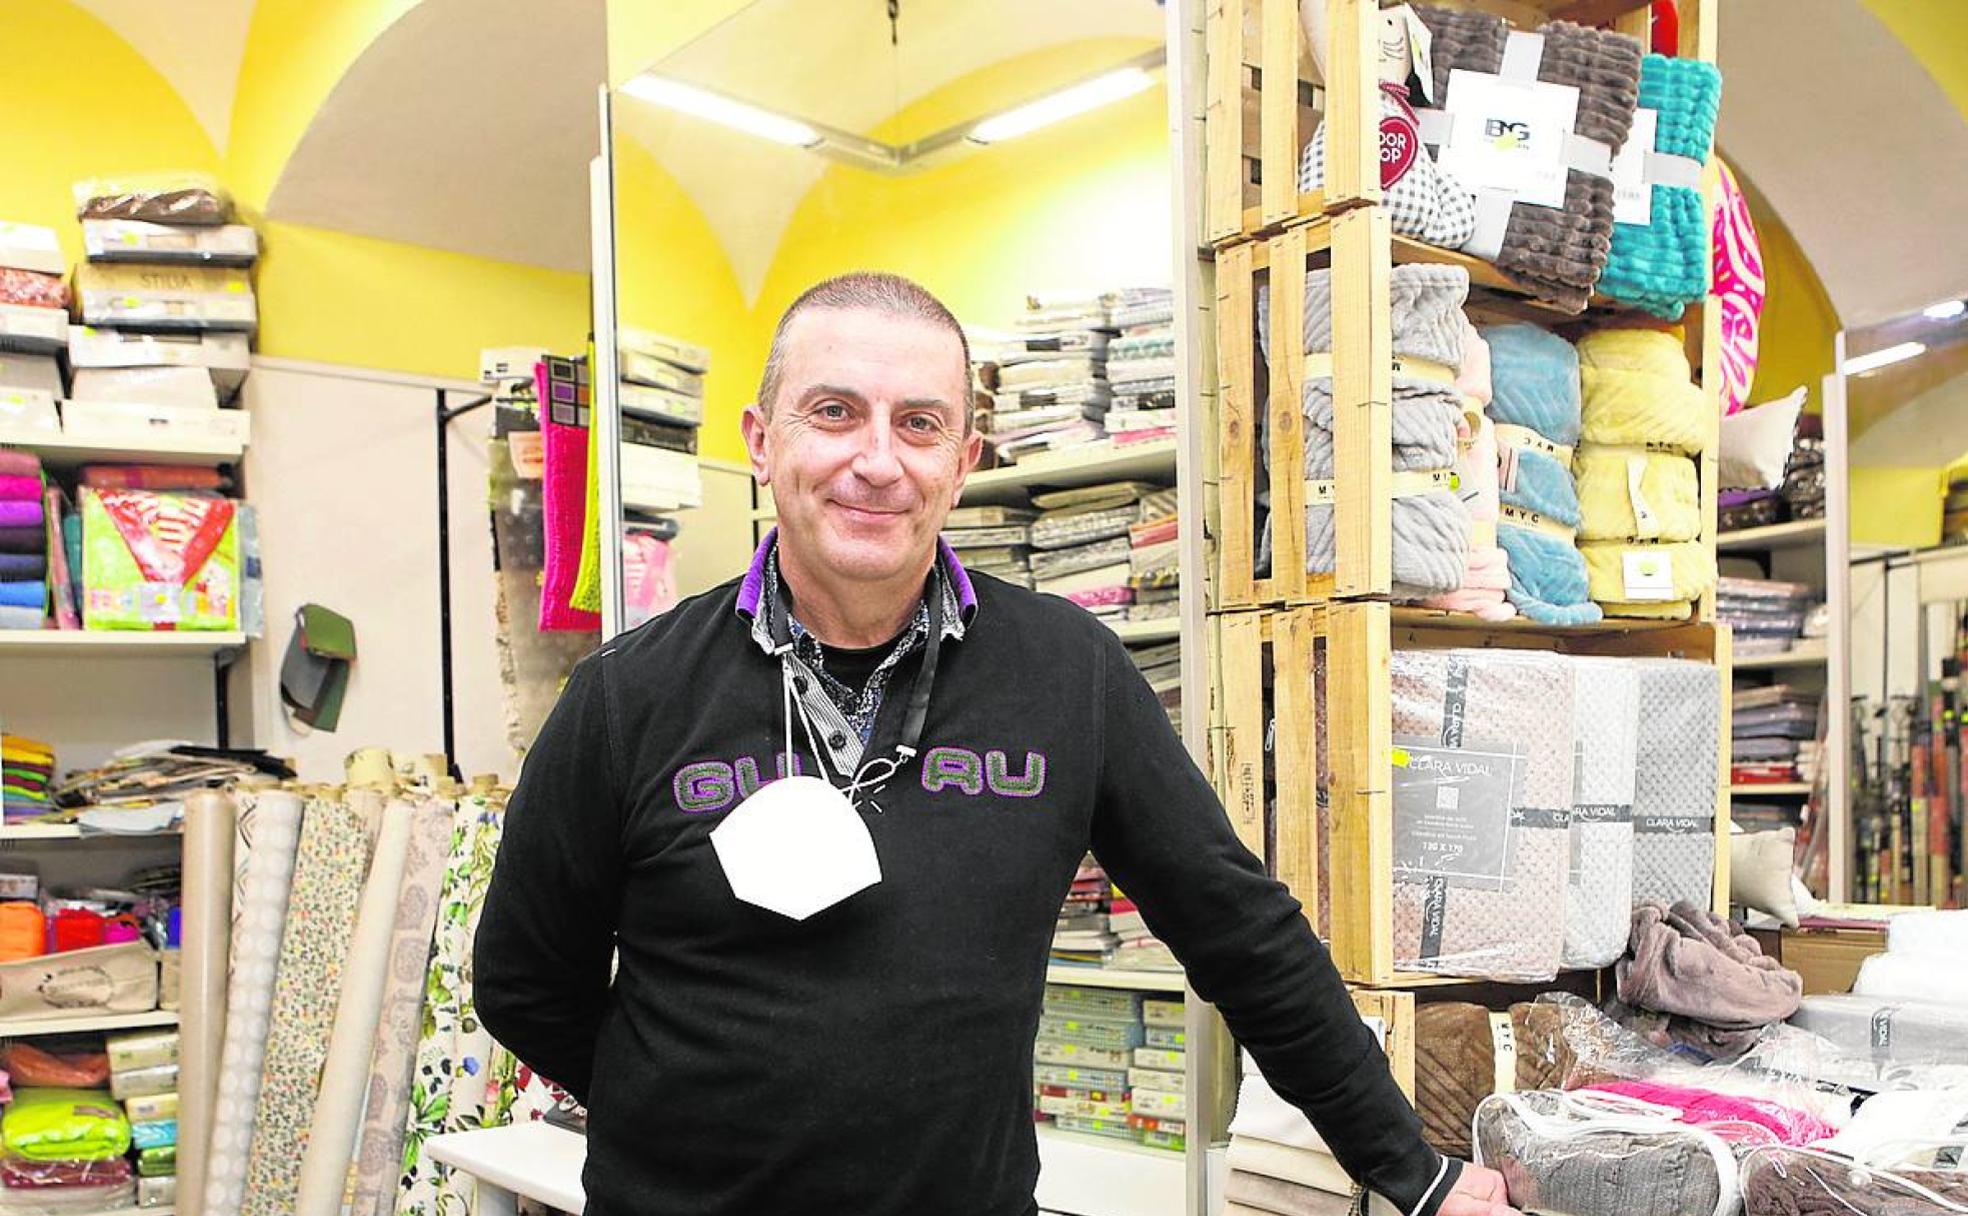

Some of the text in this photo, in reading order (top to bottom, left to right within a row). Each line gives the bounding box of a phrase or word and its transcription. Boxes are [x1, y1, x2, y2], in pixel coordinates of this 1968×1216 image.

[1505, 507, 1540, 523] MYC
[1456, 761, 1493, 776] VIDAL
[1590, 807, 1615, 817] VIDAL
[1646, 818, 1698, 829] CLARA VIDAL
